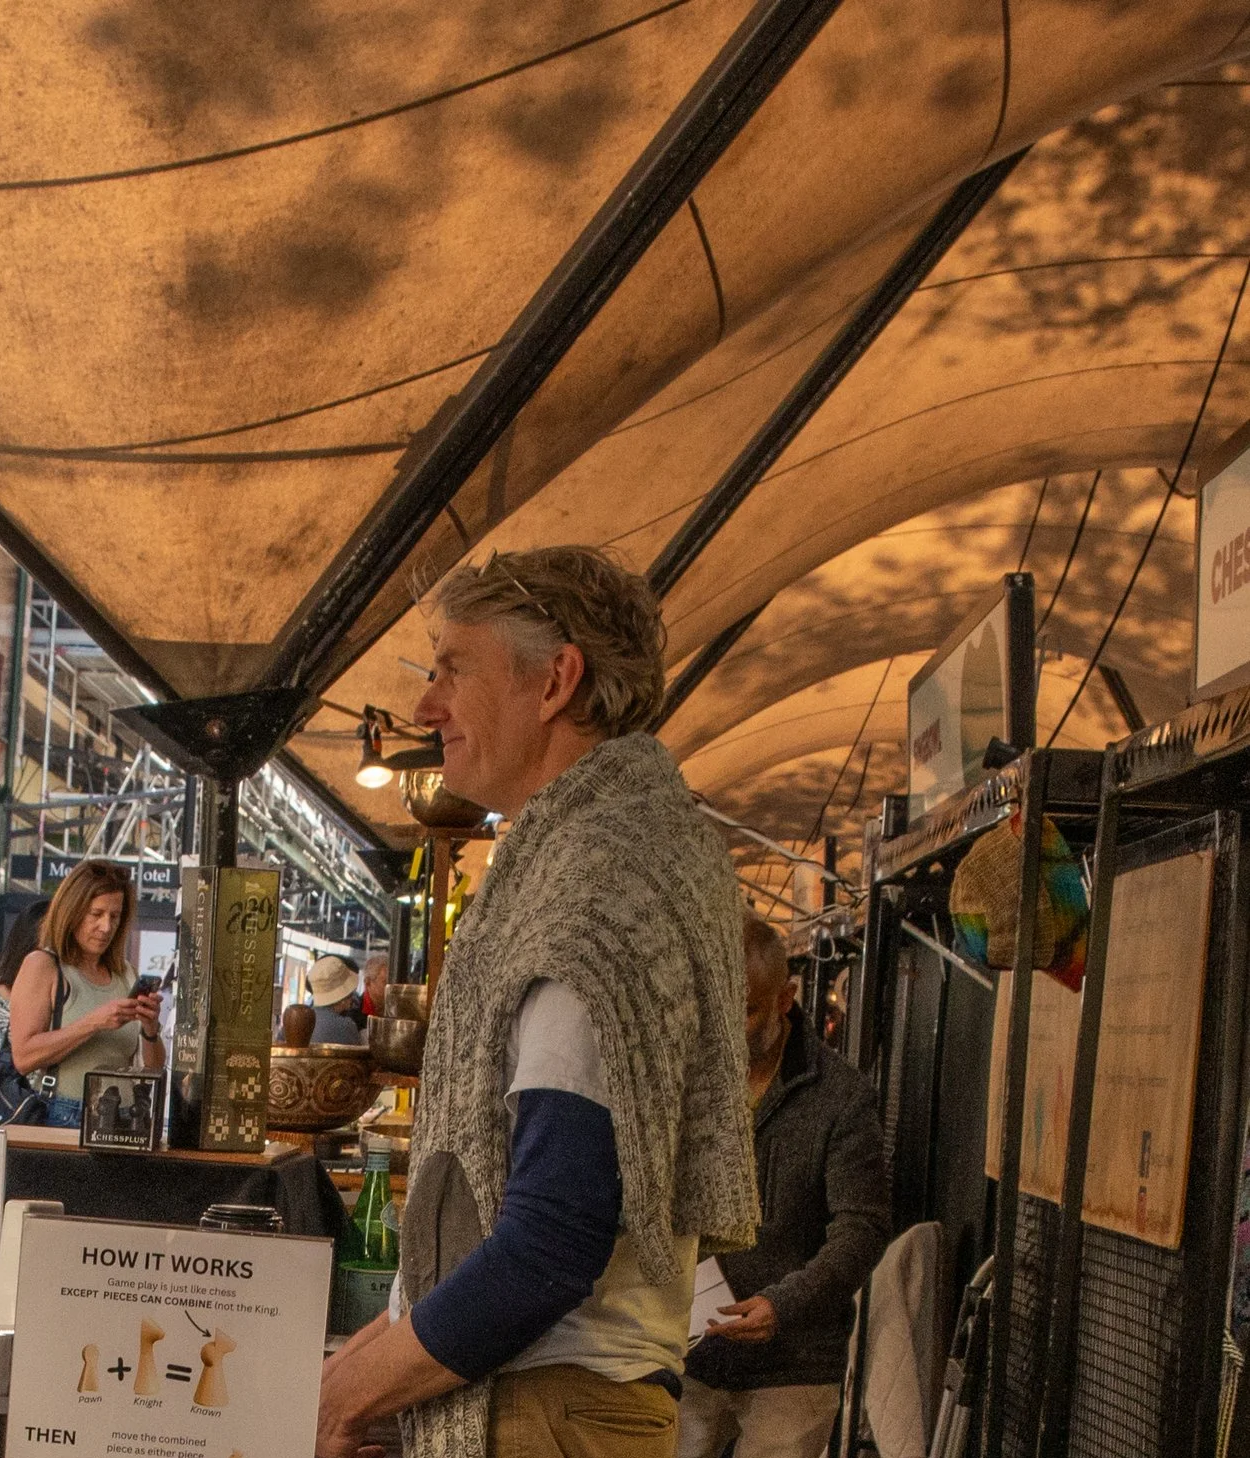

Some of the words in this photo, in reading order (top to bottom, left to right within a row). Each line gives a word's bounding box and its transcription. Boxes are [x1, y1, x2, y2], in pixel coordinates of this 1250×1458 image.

[130, 867, 170, 882] Hotel
[82, 1247, 138, 1269] HOW
[145, 1253, 164, 1271] IT
[171, 1255, 254, 1279] WORKS
[108, 1278, 135, 1289] Game
[138, 1281, 158, 1291] play
[161, 1282, 168, 1290] is
[170, 1283, 188, 1293] just
[191, 1285, 207, 1294] like
[209, 1287, 236, 1297] chess
[61, 1288, 98, 1298] EXCEPT
[103, 1292, 138, 1302] PIECES
[141, 1295, 162, 1304] CAN
[165, 1297, 212, 1309] COMBINE
[215, 1301, 234, 1311] (not
[237, 1303, 252, 1312] the
[255, 1305, 281, 1316] King).
[25, 1427, 76, 1445] THEN
[112, 1432, 138, 1442] move
[141, 1433, 156, 1443] the
[159, 1435, 206, 1447] combined
[107, 1444, 132, 1454] piece
[147, 1448, 175, 1458] either
